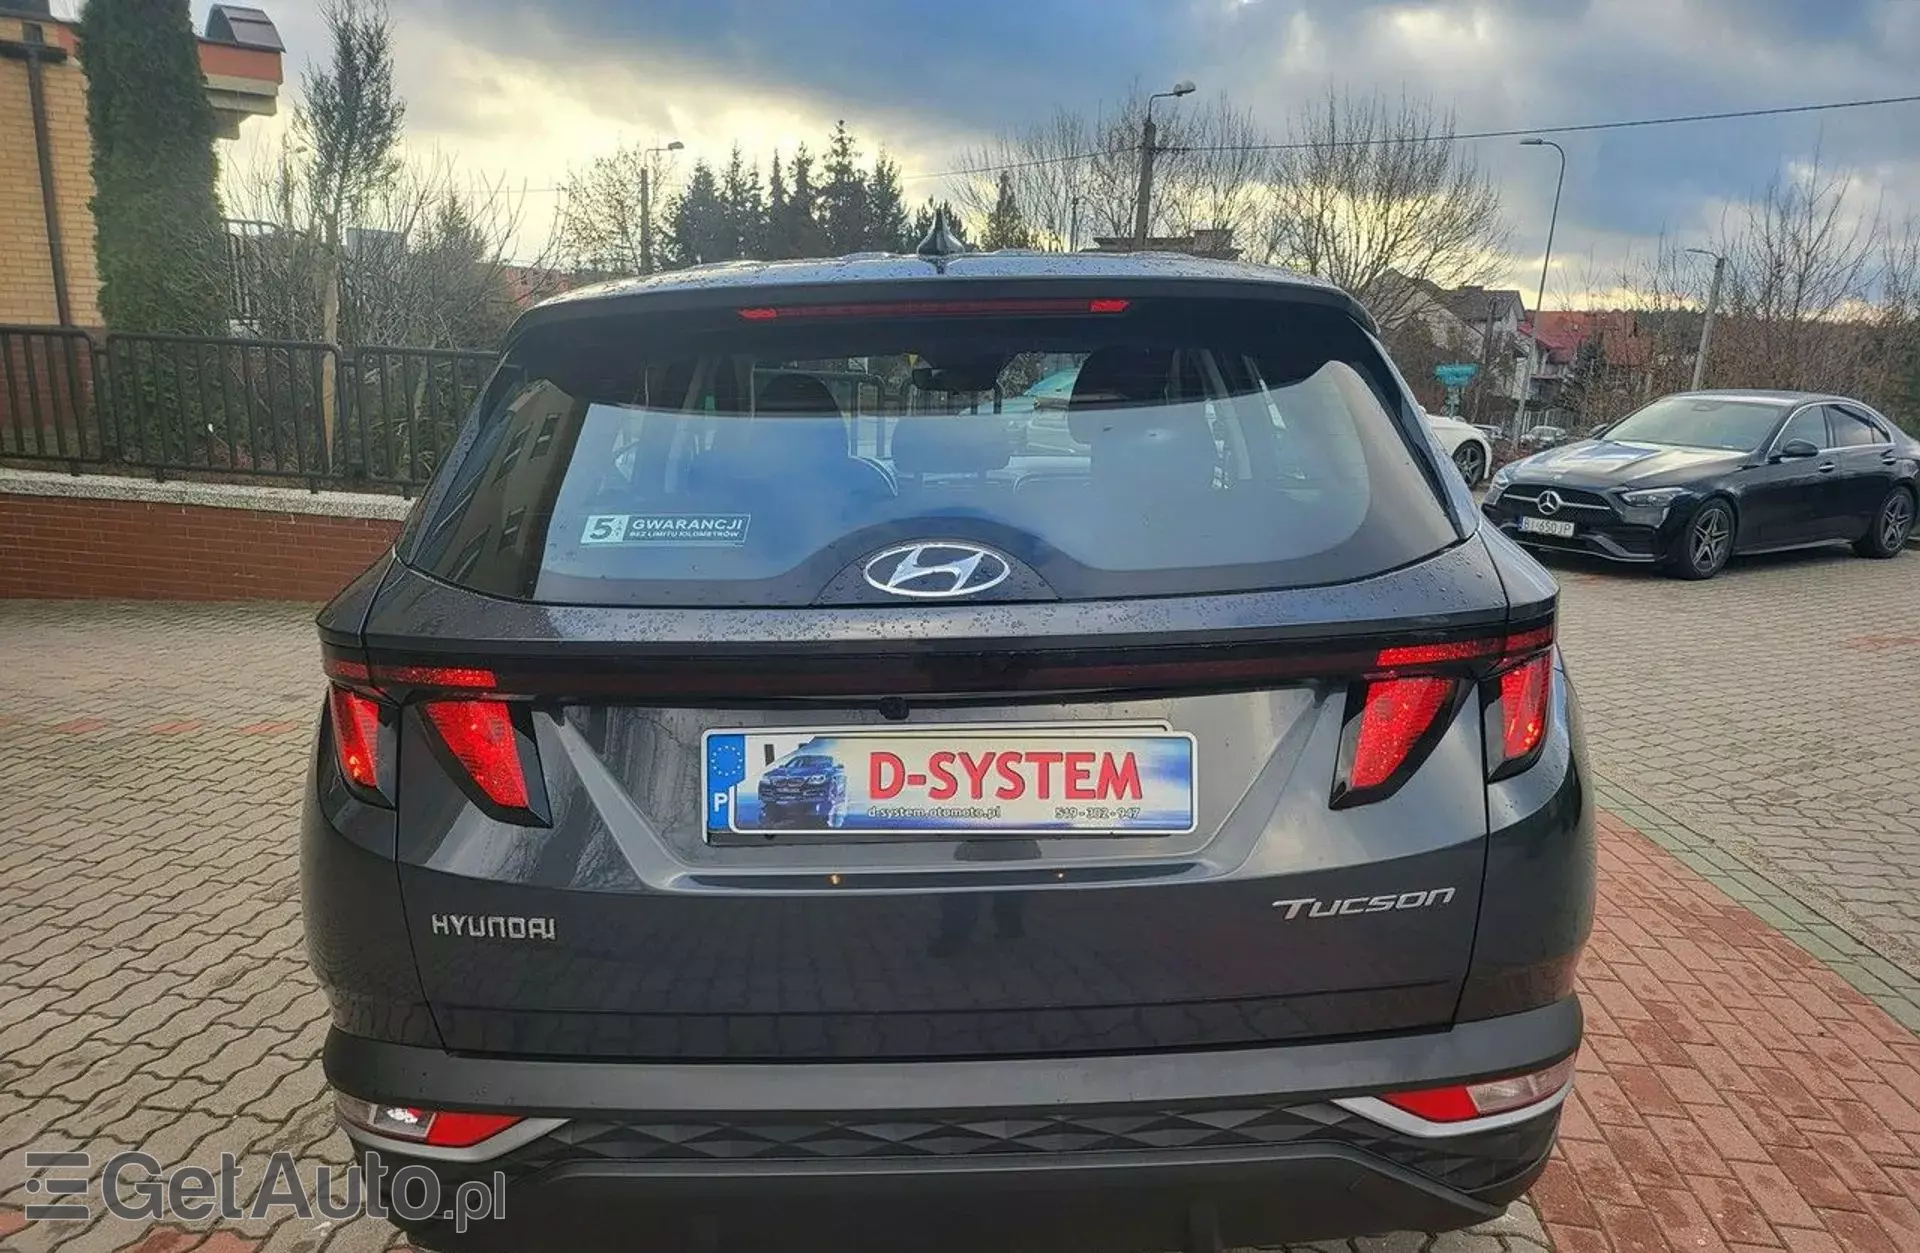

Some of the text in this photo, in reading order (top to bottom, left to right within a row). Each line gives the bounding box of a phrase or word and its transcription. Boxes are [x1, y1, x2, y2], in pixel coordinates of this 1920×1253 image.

[590, 518, 613, 540] 5
[632, 519, 743, 530] GWARANCJI
[870, 751, 1143, 800] D-SYSTEM
[868, 806, 1002, 820] d-system.otomoto.pl
[431, 914, 557, 940] HYUNDAI
